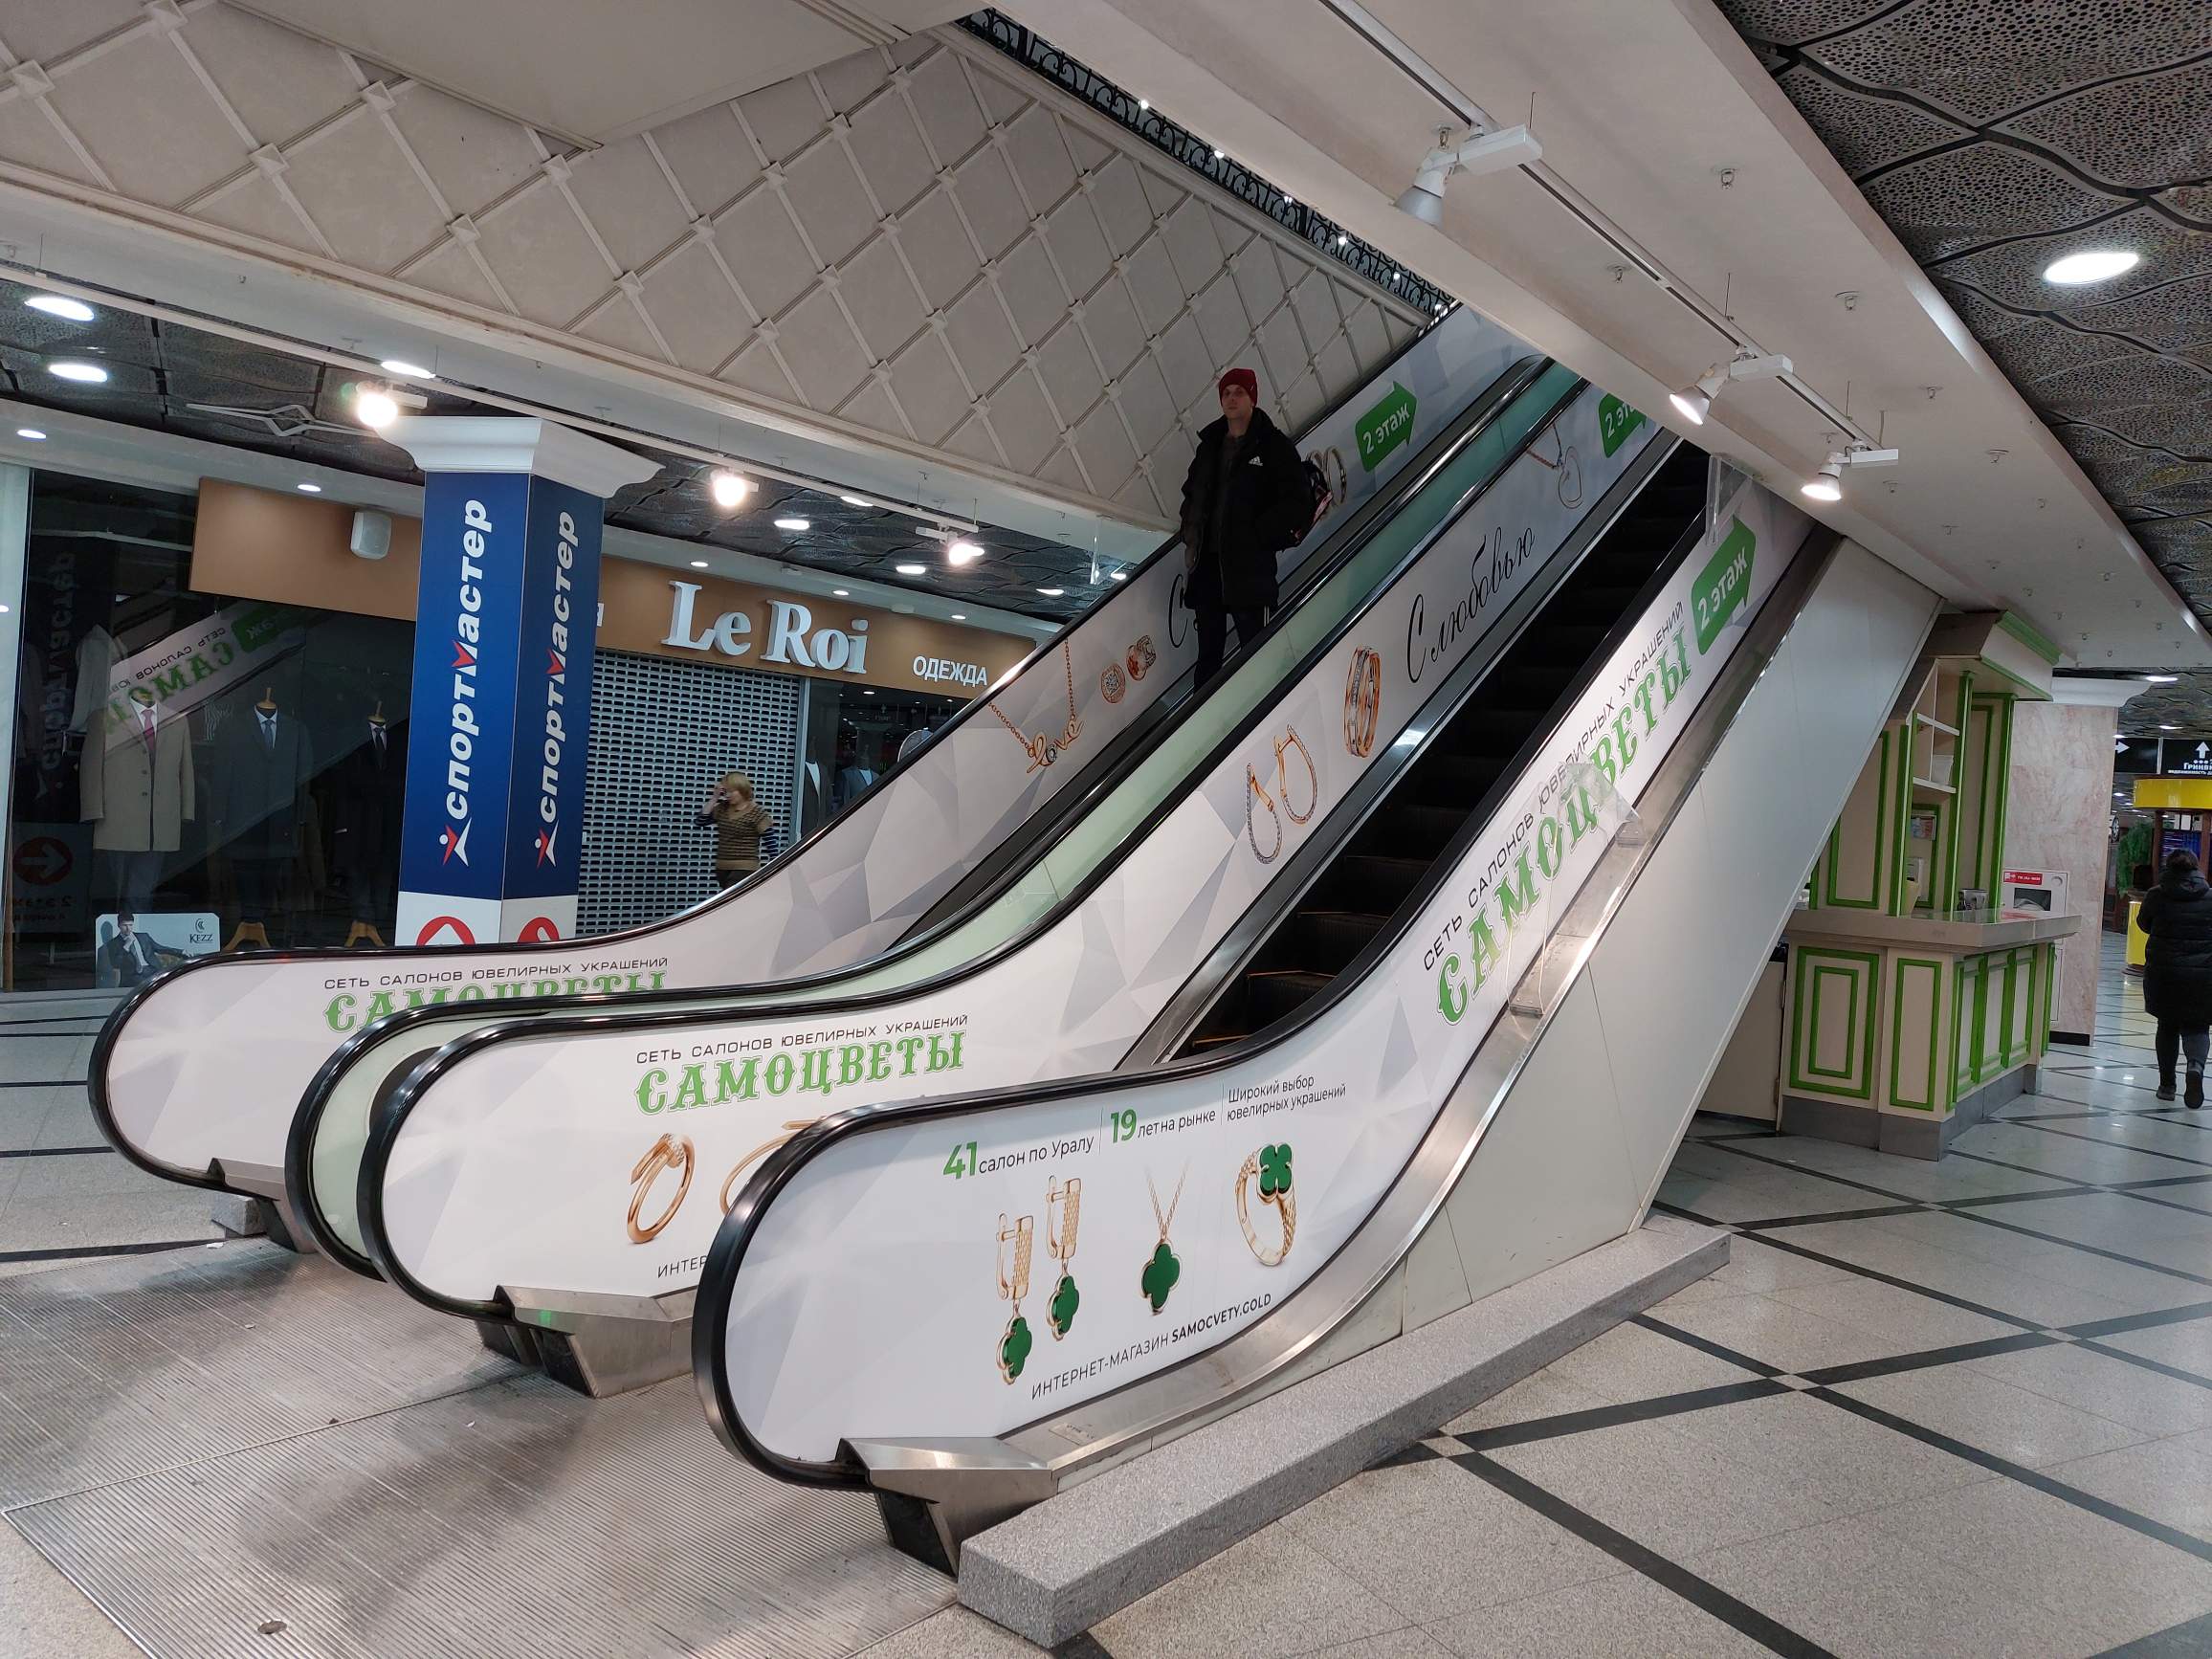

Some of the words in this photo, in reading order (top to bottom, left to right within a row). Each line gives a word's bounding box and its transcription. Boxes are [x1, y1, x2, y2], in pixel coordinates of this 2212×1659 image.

[1362, 431, 1375, 454] 2
[1375, 402, 1410, 444] этаж
[1604, 412, 1616, 438] 2
[1616, 402, 1636, 427] эт
[1431, 526, 1536, 663] любовью
[1697, 597, 1711, 631] 2
[1711, 546, 1749, 612] этаж
[660, 580, 752, 656] Le
[760, 598, 870, 675] Roi
[912, 655, 988, 687] ОДЕЖДА
[1423, 915, 1463, 971] СЕТЬ
[1467, 812, 1535, 909] САЛОНОВ
[1538, 697, 1615, 814] ЮВЕЛИРНЫХ
[1618, 601, 1684, 697] УКРАШЕНИЙ
[1437, 622, 1692, 1026] САМОЦВЕТЫ
[189, 933, 214, 943] KEZZ
[323, 977, 370, 989] СЕТЬ
[380, 971, 463, 986] САЛОНОВ
[471, 963, 573, 981] ЮВЕЛИРНЫХ
[580, 957, 669, 972] УКРАШЕНИЙ
[636, 1048, 682, 1065] СЕТЬ
[691, 1038, 773, 1058] САЛОНОВ
[780, 1027, 877, 1047] ЮВЕЛИРНЫХ
[885, 1014, 969, 1035] УКРАШЕНИЙ
[633, 1030, 968, 1116] САМОЦВЕТЫ
[1228, 1081, 1280, 1104] Широкий
[1281, 1074, 1316, 1094] выбор
[1110, 1108, 1139, 1143] 19
[1138, 1121, 1161, 1139] лет
[1160, 1118, 1176, 1134] на
[1178, 1108, 1217, 1133] рынке
[1227, 1098, 1290, 1122] ювелирных
[1290, 1082, 1347, 1112] украшений
[942, 1140, 978, 1180] 41
[978, 1150, 1026, 1175] салон
[1028, 1146, 1049, 1164] по
[1051, 1136, 1095, 1161] Уралу
[1031, 1332, 1169, 1401] ИНТЕРНЕТ-МАГАЗИН
[1171, 1294, 1272, 1343] SAMOCVETY.GOLD
